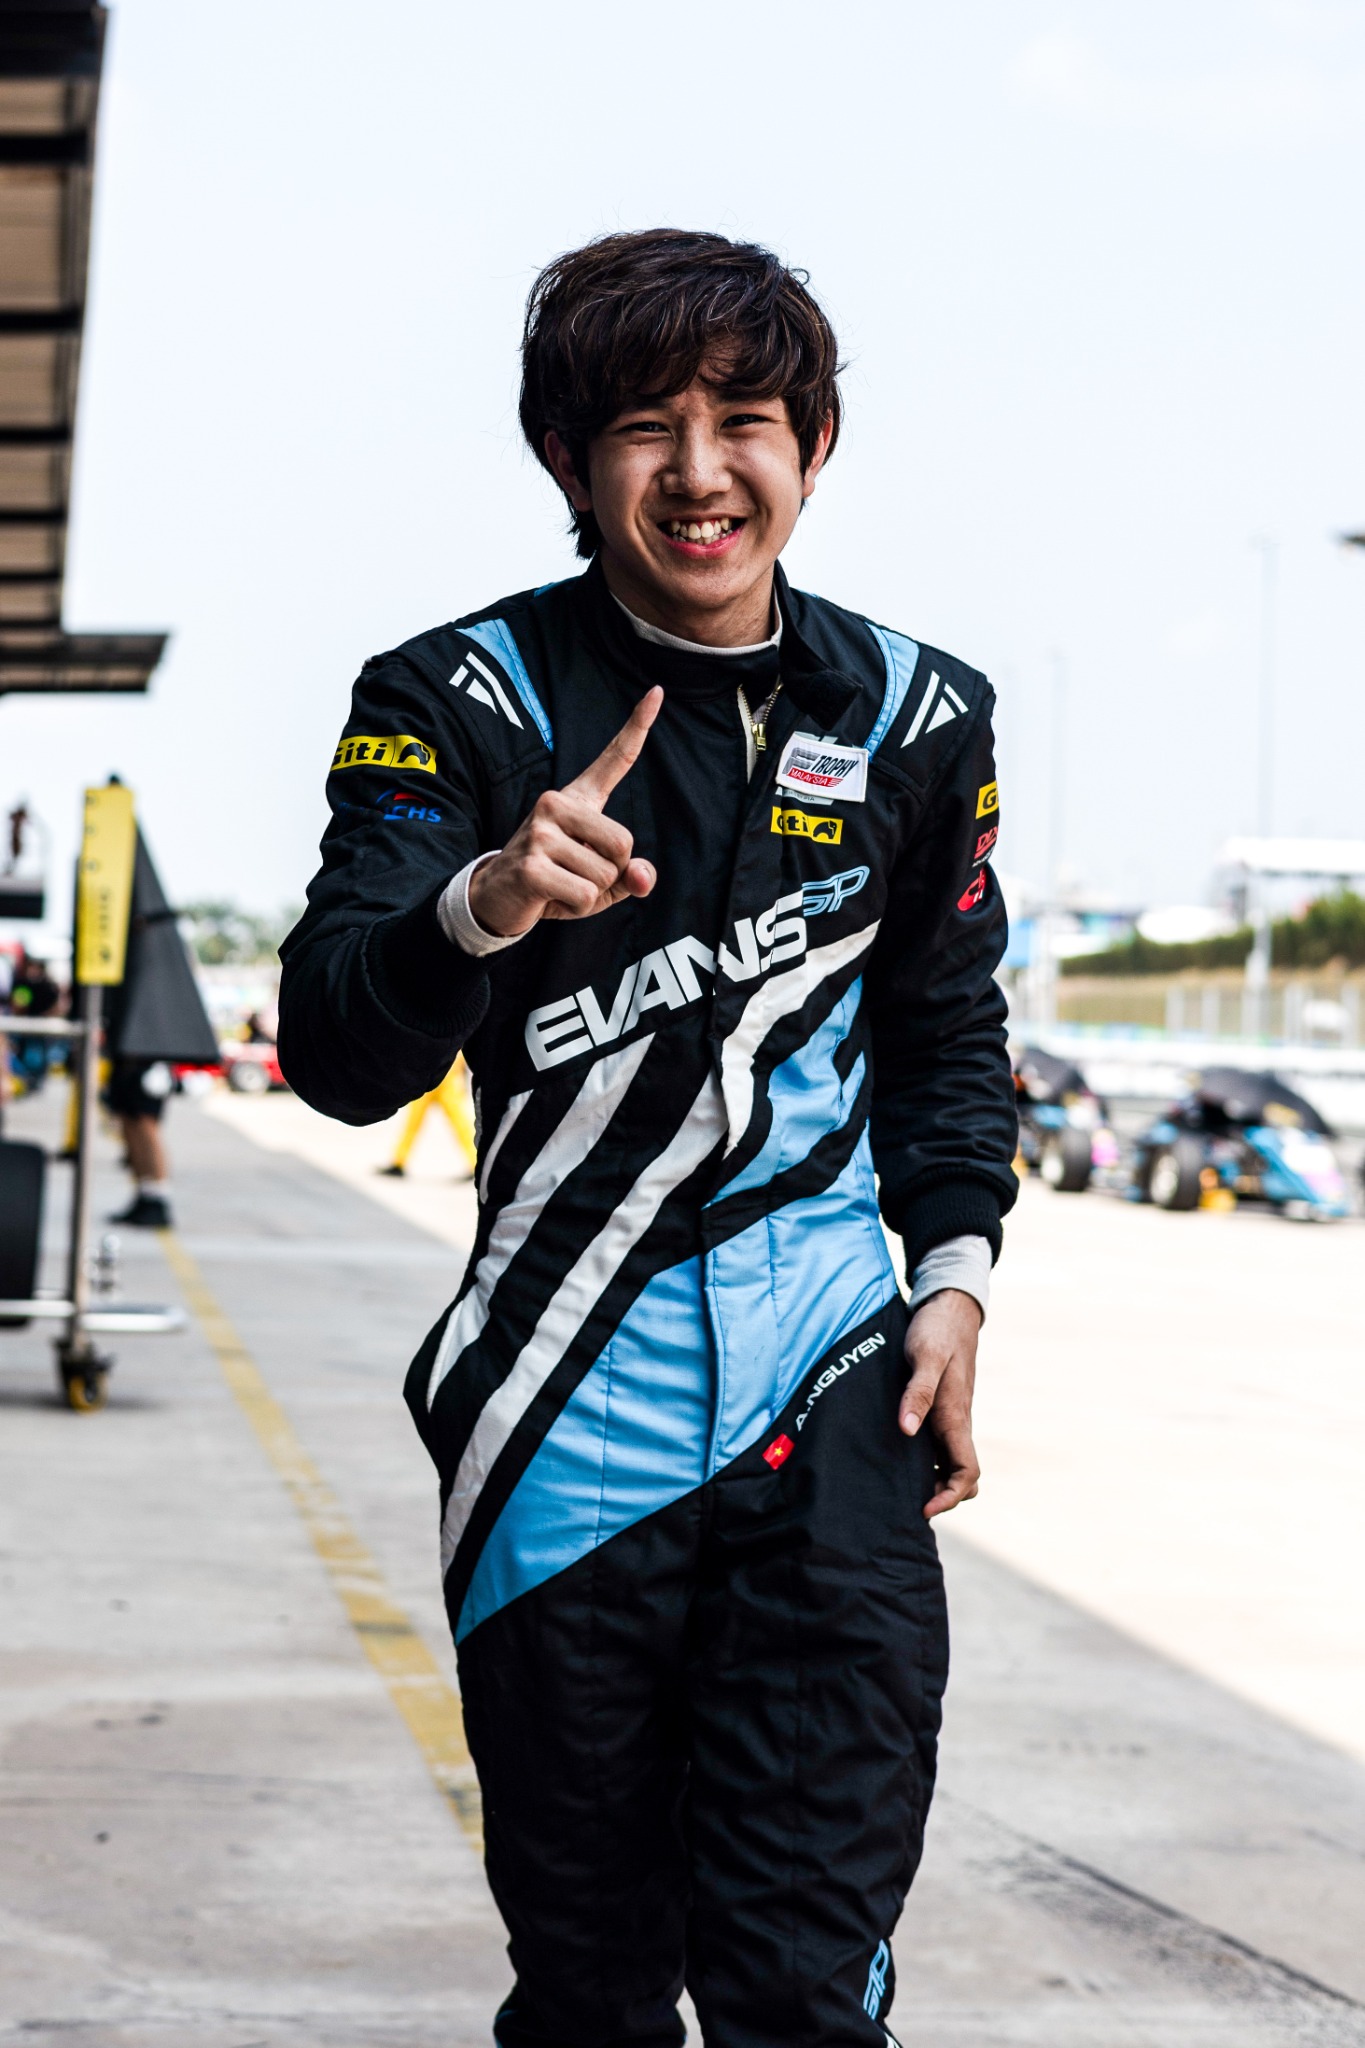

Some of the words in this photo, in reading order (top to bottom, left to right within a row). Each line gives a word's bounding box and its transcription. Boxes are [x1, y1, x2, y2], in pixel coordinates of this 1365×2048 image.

[791, 769, 828, 787] MALAYSIA
[811, 755, 859, 778] TROPHY
[525, 889, 807, 1072] EVANS
[795, 1332, 887, 1432] A.NGUYEN
